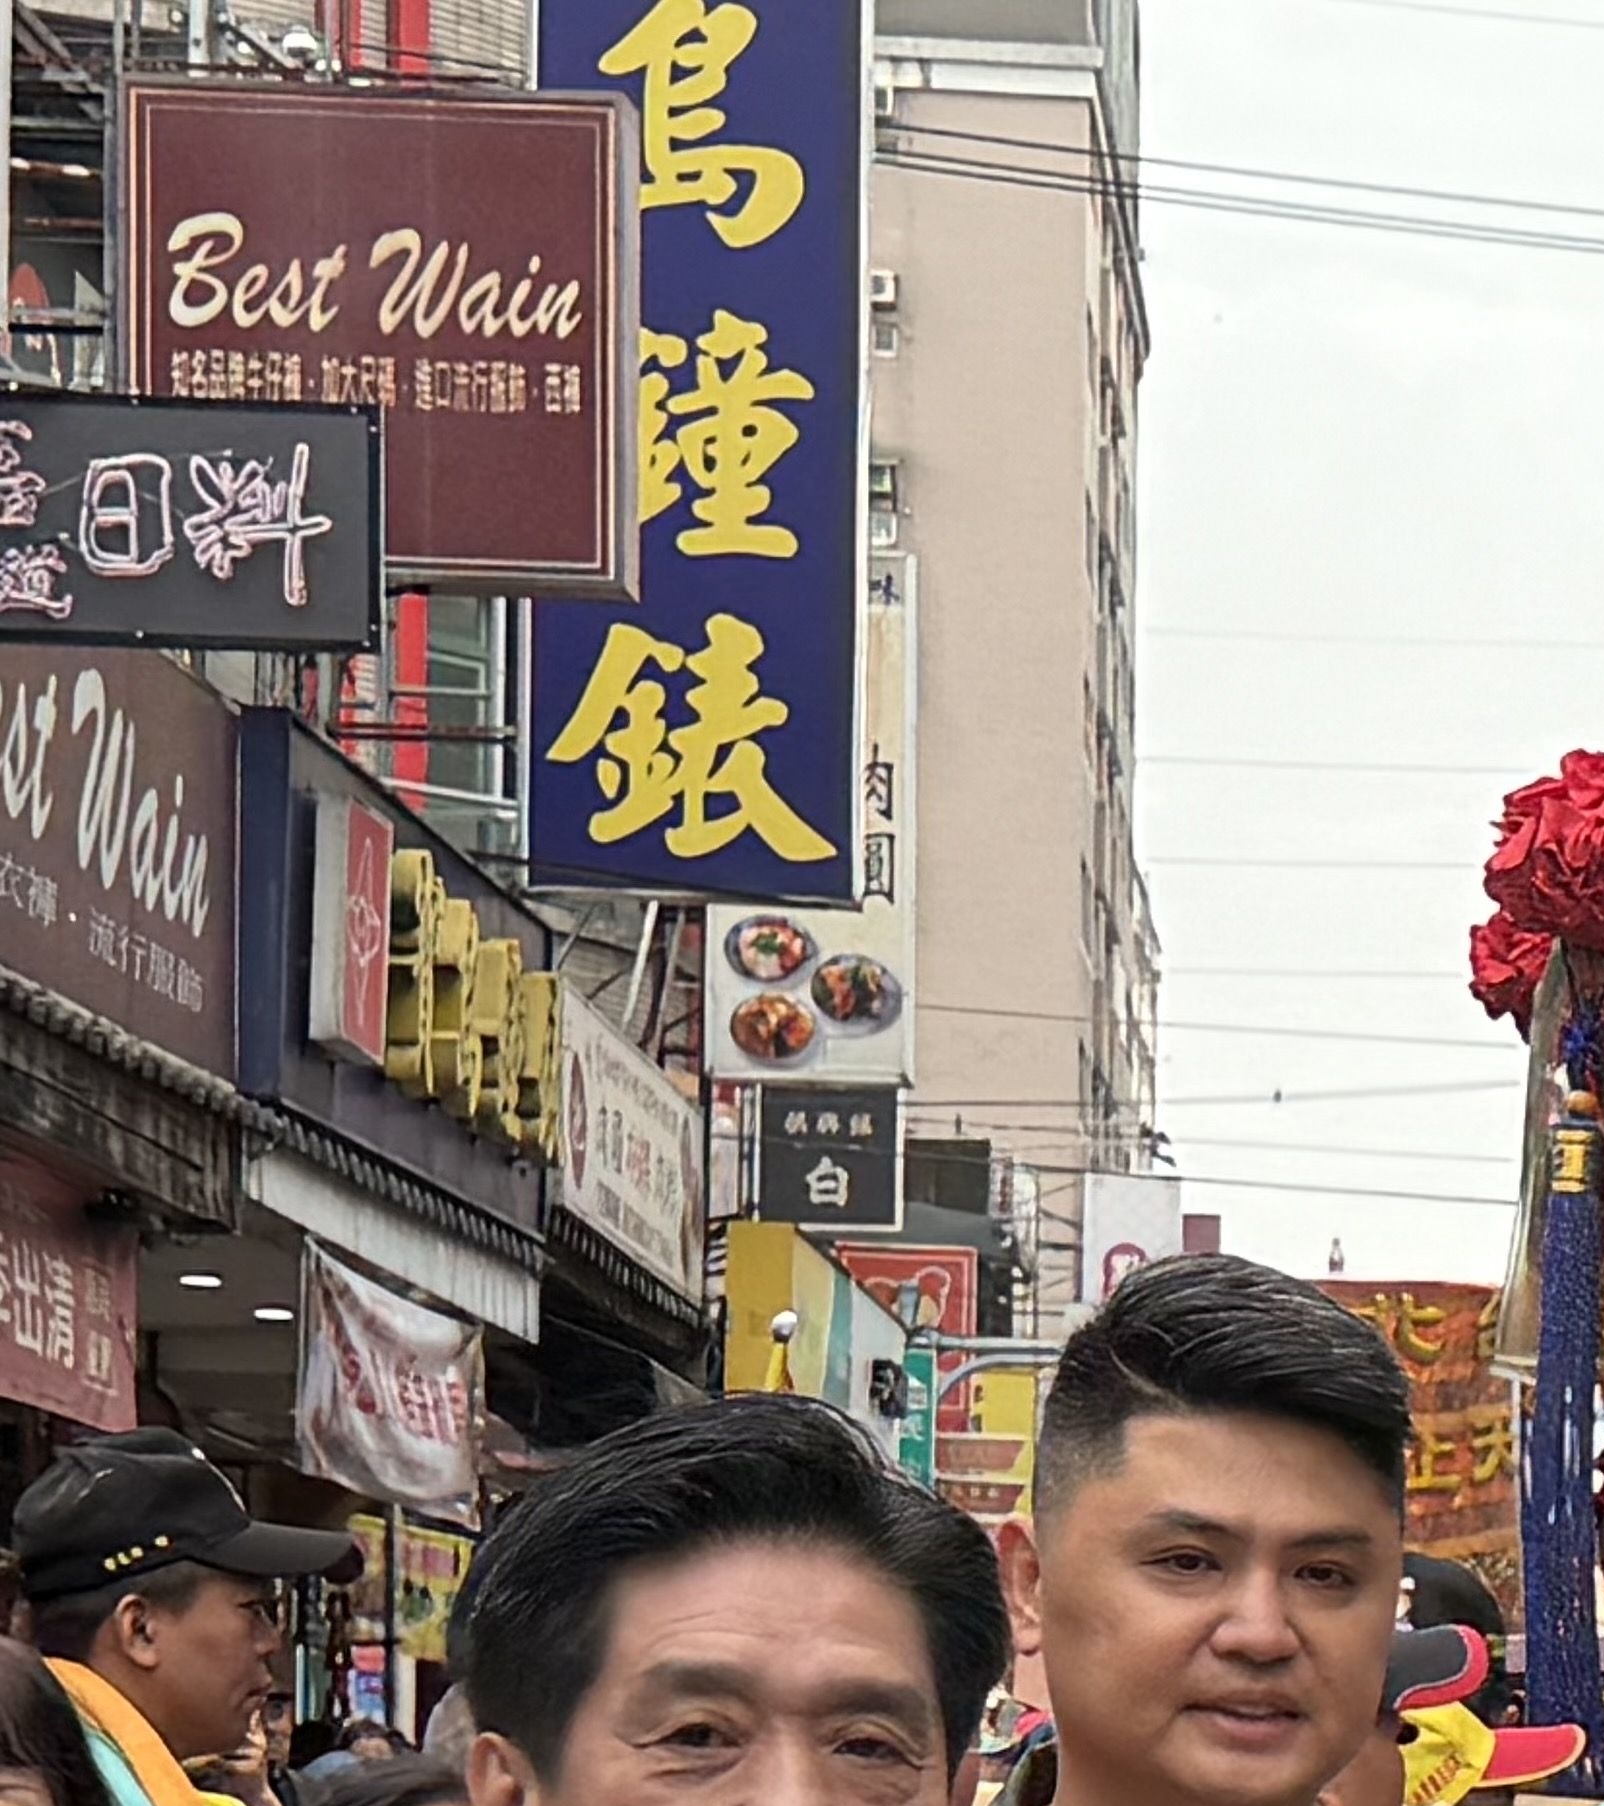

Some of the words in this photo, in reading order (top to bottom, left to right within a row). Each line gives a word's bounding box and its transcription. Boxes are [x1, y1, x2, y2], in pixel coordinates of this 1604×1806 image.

[168, 212, 349, 330] Best
[369, 228, 584, 340] Wain
[72, 668, 211, 938] Wain
